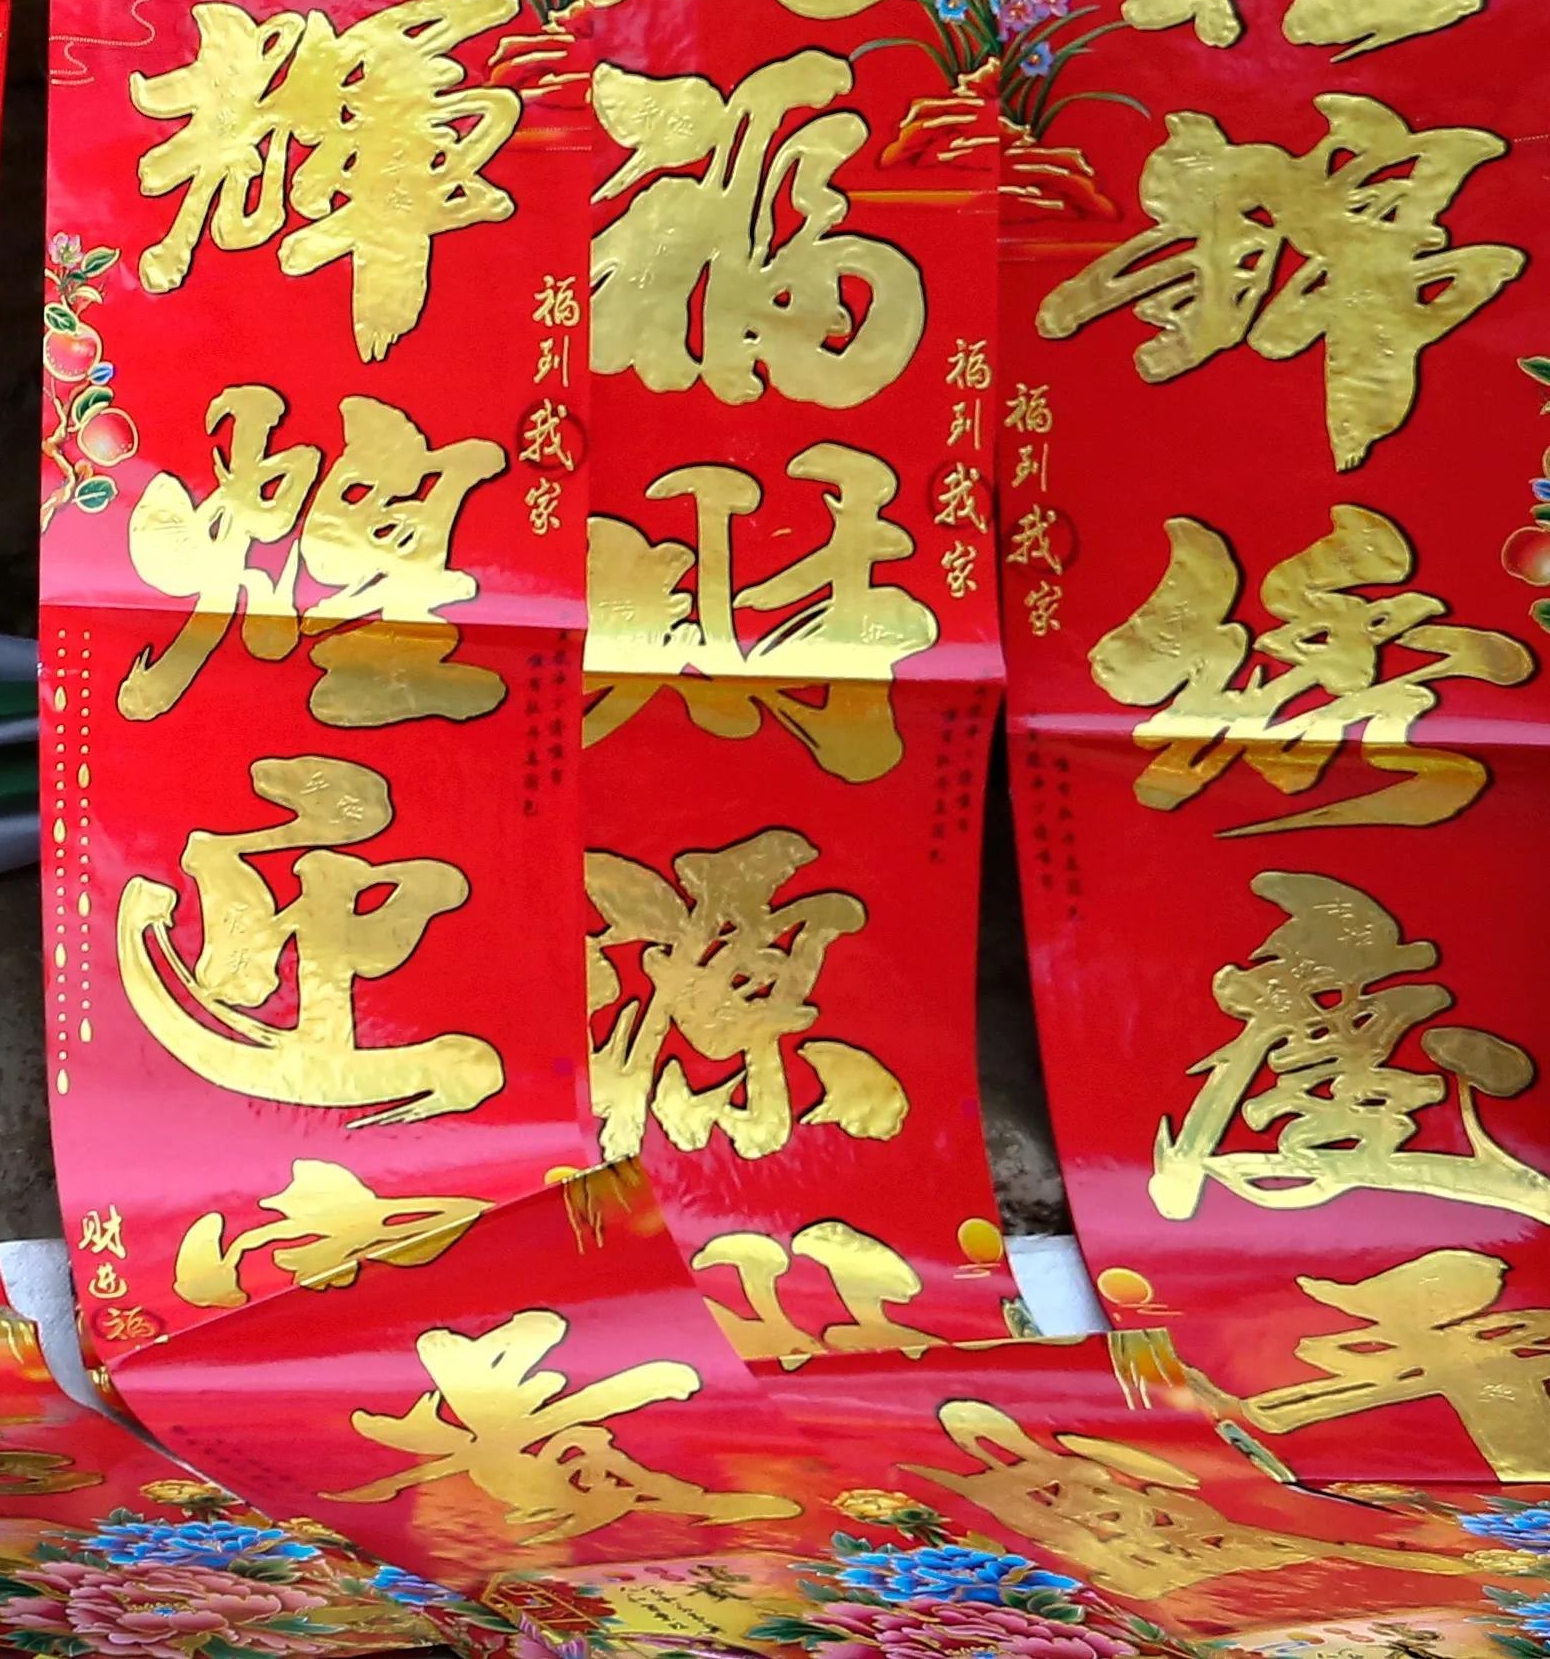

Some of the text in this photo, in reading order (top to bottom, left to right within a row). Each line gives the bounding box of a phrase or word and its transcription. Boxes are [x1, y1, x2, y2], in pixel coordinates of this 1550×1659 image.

[518, 274, 581, 536] 福到我家
[933, 338, 992, 598] 福到我家
[1003, 382, 1063, 637] 福到我家
